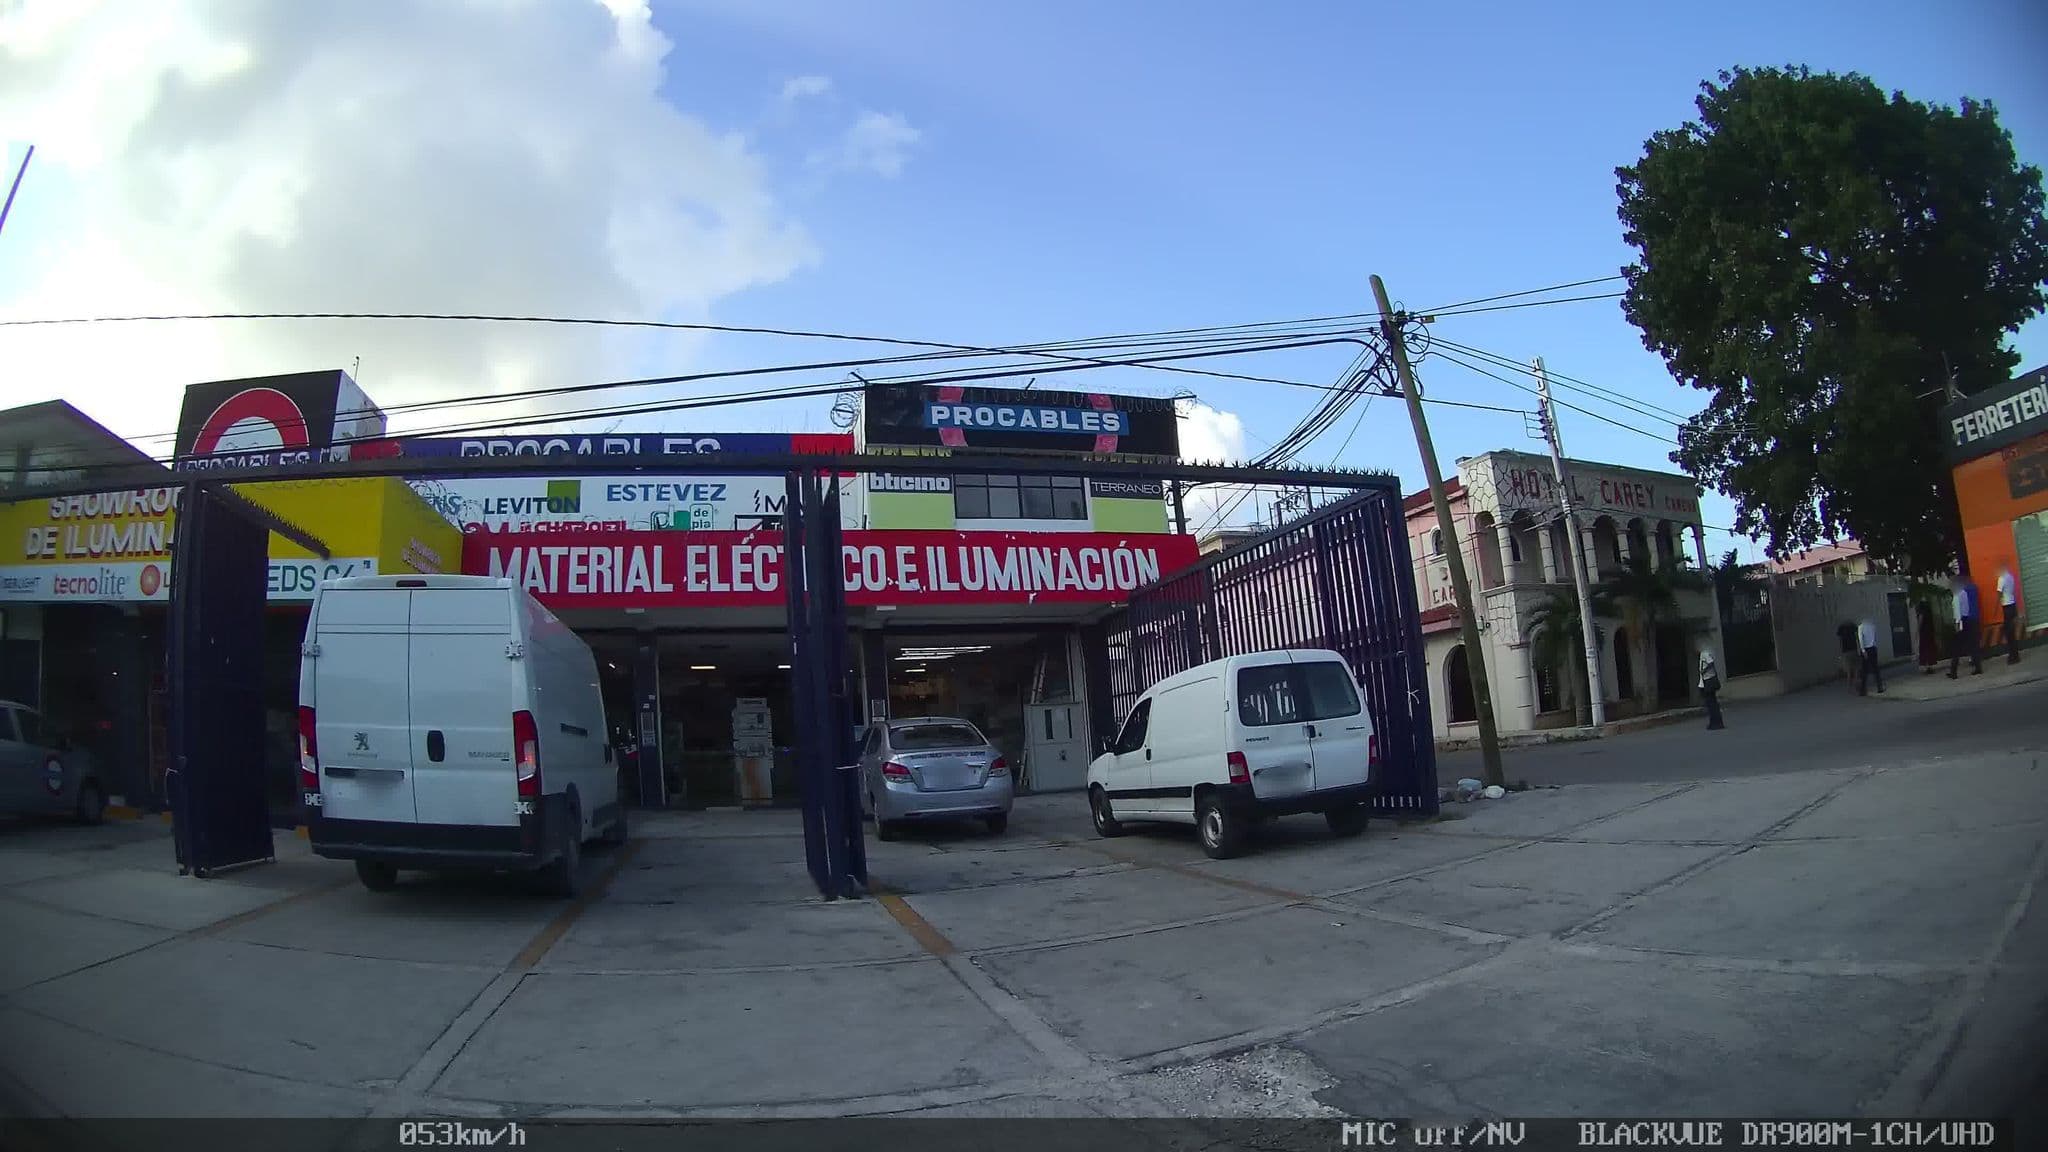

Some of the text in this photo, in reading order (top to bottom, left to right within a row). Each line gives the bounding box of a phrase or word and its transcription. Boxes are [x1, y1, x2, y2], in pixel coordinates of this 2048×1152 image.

[931, 405, 1120, 432] PROCABLES
[607, 484, 726, 501] ESTEVEZ
[869, 473, 951, 491] bticino
[1091, 481, 1162, 495] TERRANEO
[1600, 479, 1654, 507] CAREY
[484, 496, 581, 515] LEVITON
[25, 527, 59, 559] DE
[487, 546, 673, 594] MATERIAL
[896, 545, 918, 591] E
[926, 540, 1160, 592] ILUMINACIÓN
[54, 567, 126, 595] tecnolite
